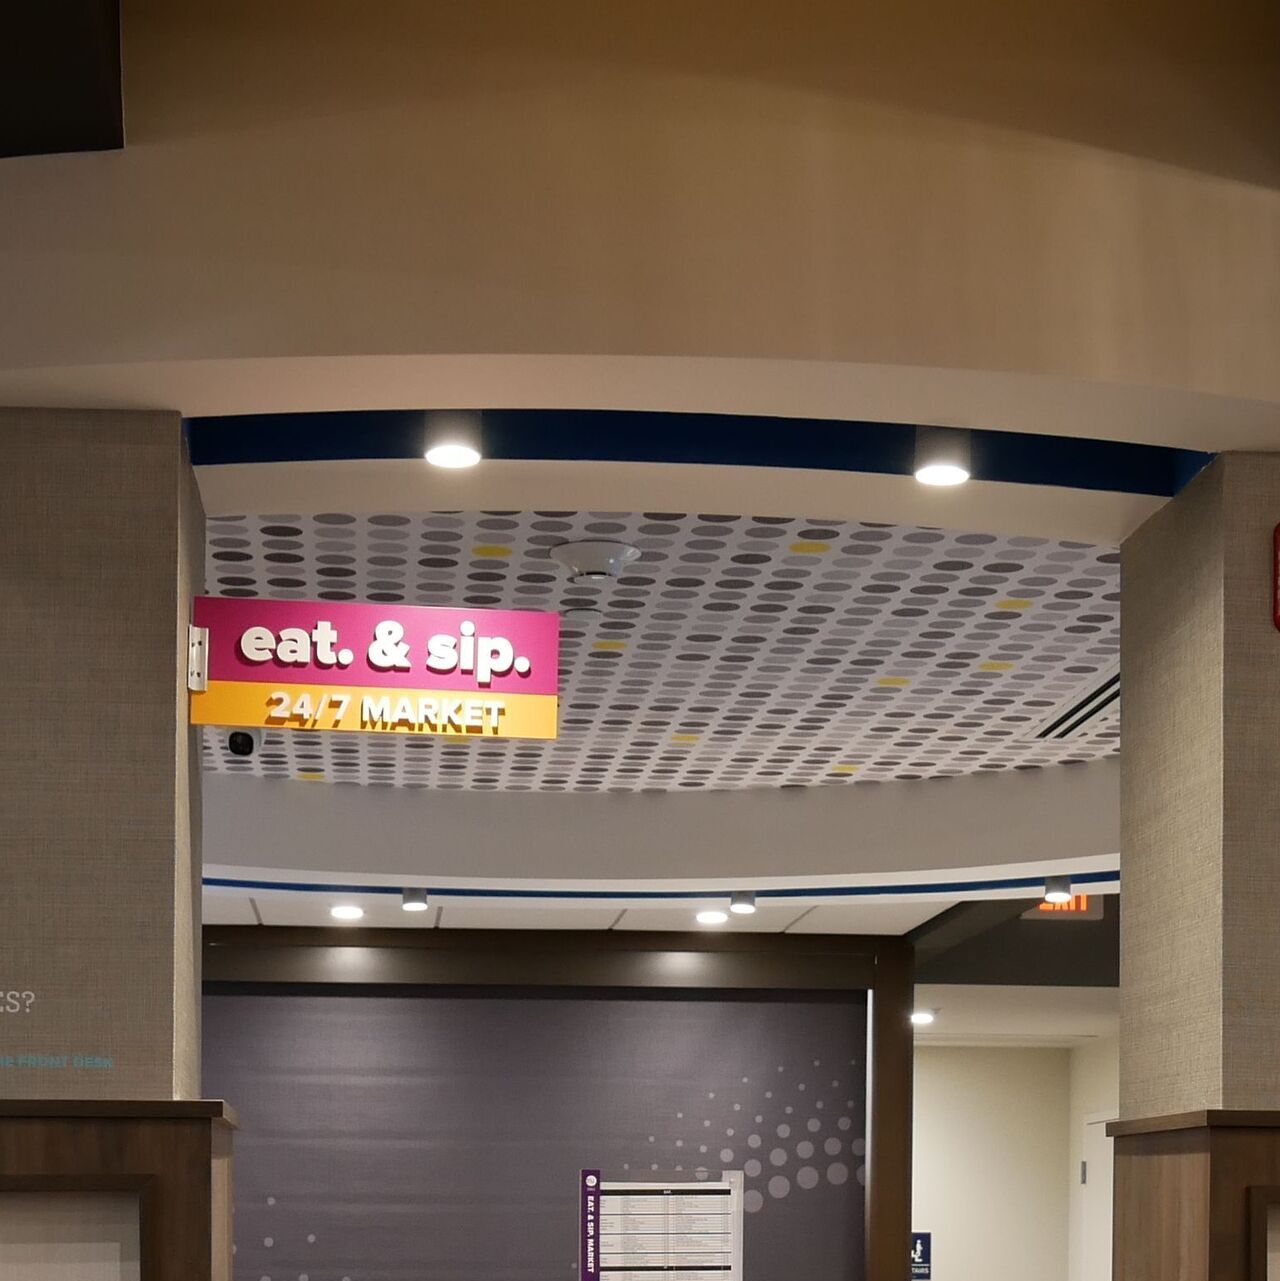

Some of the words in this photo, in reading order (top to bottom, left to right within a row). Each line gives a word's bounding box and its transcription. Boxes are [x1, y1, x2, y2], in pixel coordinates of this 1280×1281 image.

[240, 621, 354, 666] eat.
[368, 620, 412, 668] &
[426, 621, 531, 684] sip.
[268, 691, 351, 722] 24/7
[362, 694, 506, 728] MARKET
[18, 1055, 68, 1068] FRONT
[73, 1056, 113, 1069] DESK
[587, 1195, 595, 1213] EAT.
[587, 1222, 595, 1237] SIP.
[587, 1238, 596, 1274] MARKET
